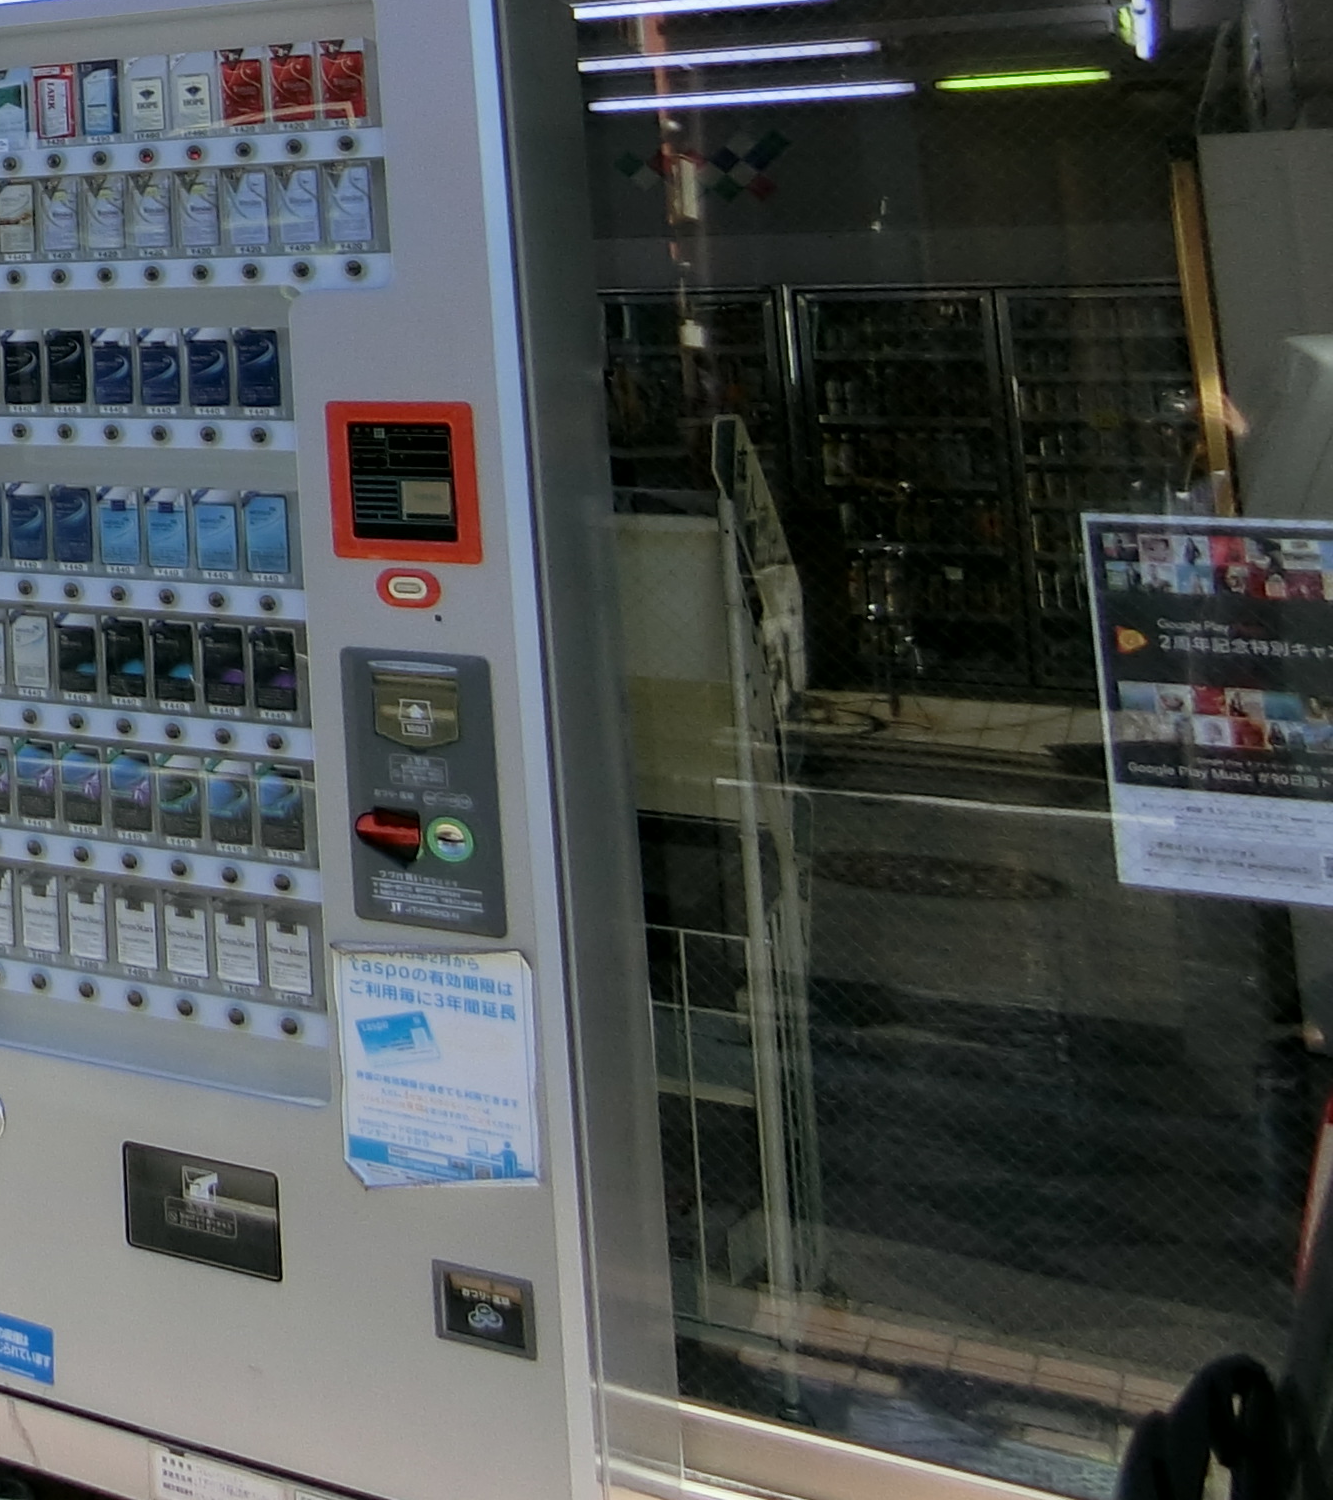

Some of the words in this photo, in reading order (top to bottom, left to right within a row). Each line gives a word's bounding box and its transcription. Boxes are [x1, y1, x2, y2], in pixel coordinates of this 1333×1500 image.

[349, 954, 514, 996] taspoの有効期限は
[349, 978, 517, 1022] ご利用毎に3年間延長
